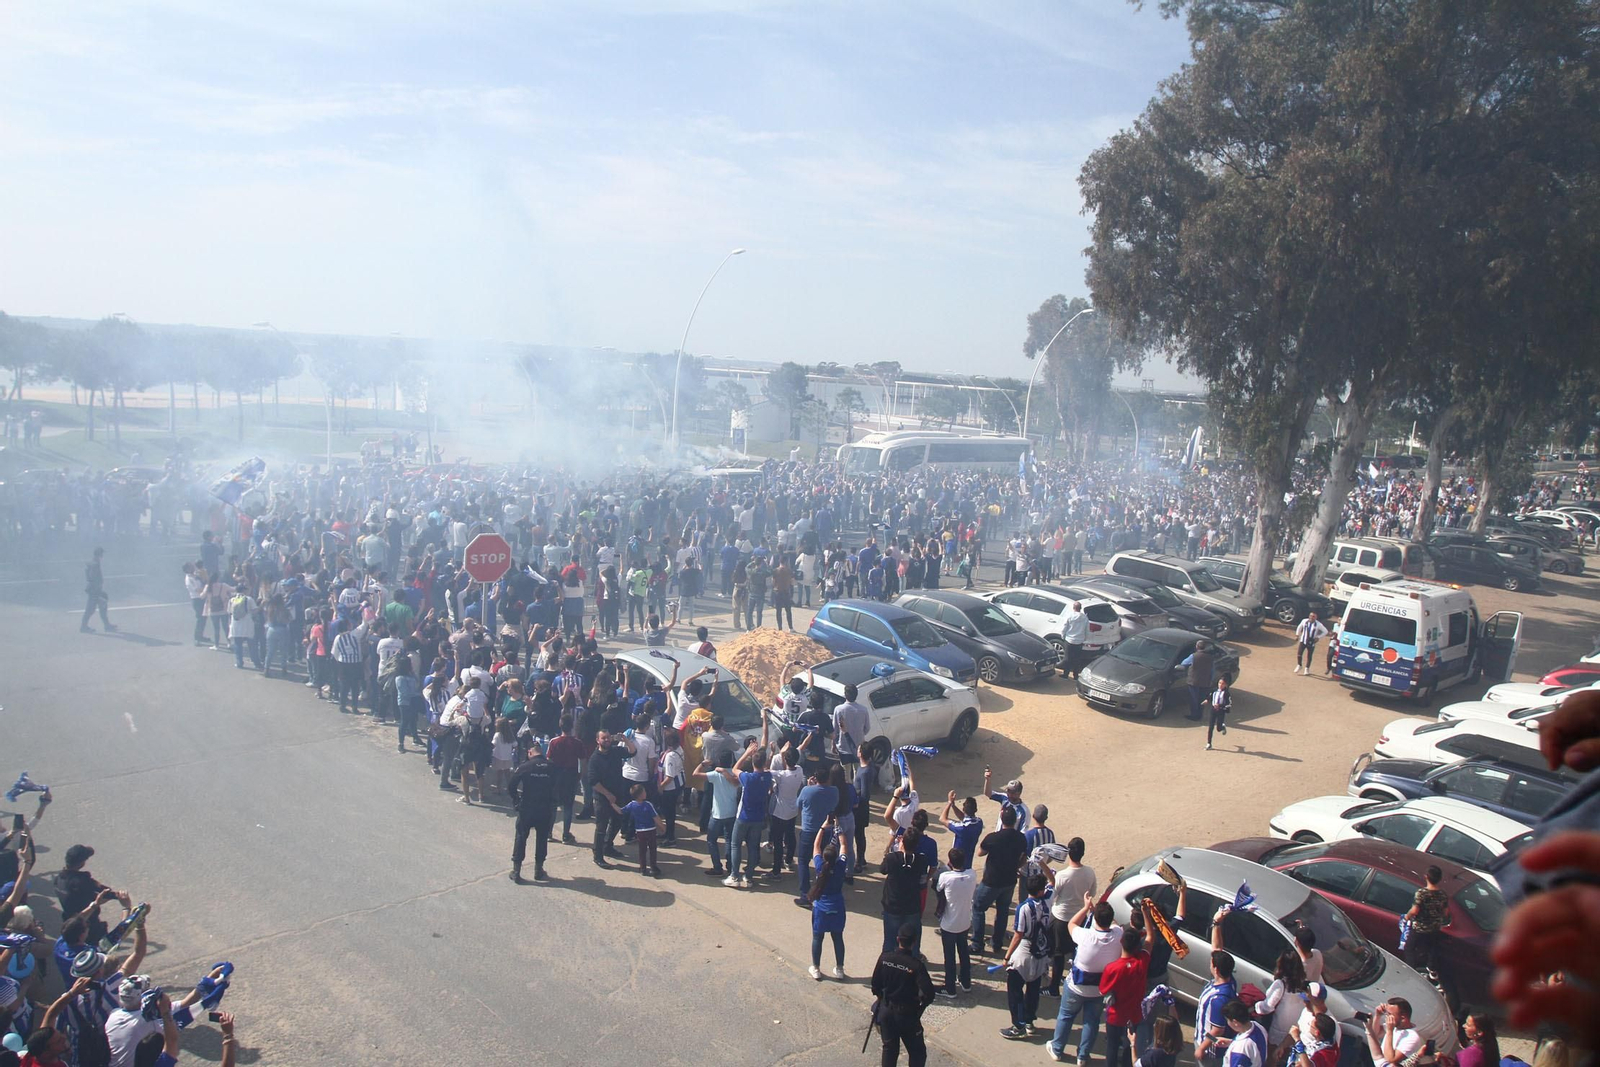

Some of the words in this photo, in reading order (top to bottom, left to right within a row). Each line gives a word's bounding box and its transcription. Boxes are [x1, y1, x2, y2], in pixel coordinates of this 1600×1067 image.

[470, 553, 506, 564] STOP
[641, 577, 647, 587] 6
[1360, 601, 1407, 617] URGENCIAS
[1375, 666, 1409, 676] AMBULANCIA
[791, 701, 800, 713] 5
[883, 961, 909, 971] POLICIA
